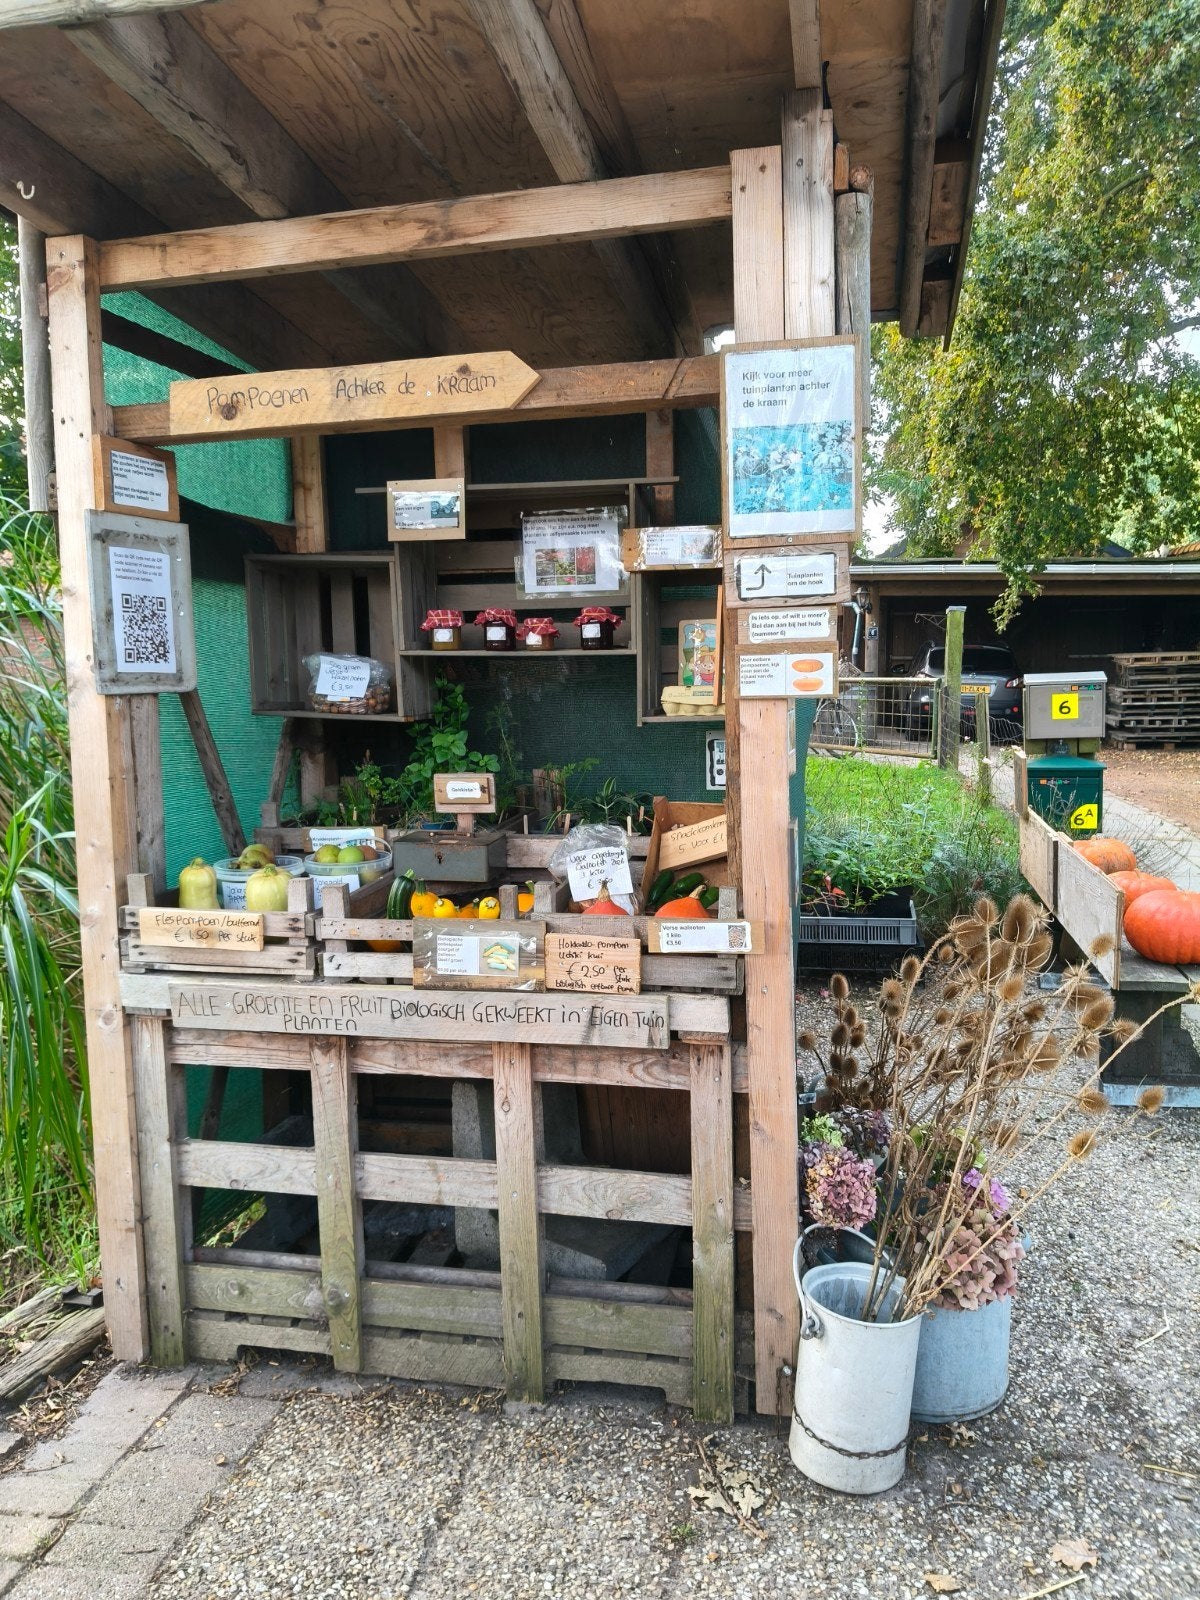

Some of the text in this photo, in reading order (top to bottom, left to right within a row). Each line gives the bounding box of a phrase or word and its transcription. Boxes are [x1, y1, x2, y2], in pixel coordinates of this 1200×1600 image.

[742, 369, 813, 382] Kijk voor meer
[397, 372, 416, 395] de
[742, 381, 830, 395] tuinplanten achter
[742, 398, 787, 408] de kraam
[1058, 700, 1071, 714] 6
[1074, 808, 1094, 826] 6A
[679, 844, 686, 854] 5
[178, 992, 221, 1017] ALLE
[472, 1002, 556, 1024] GEKWEEKT
